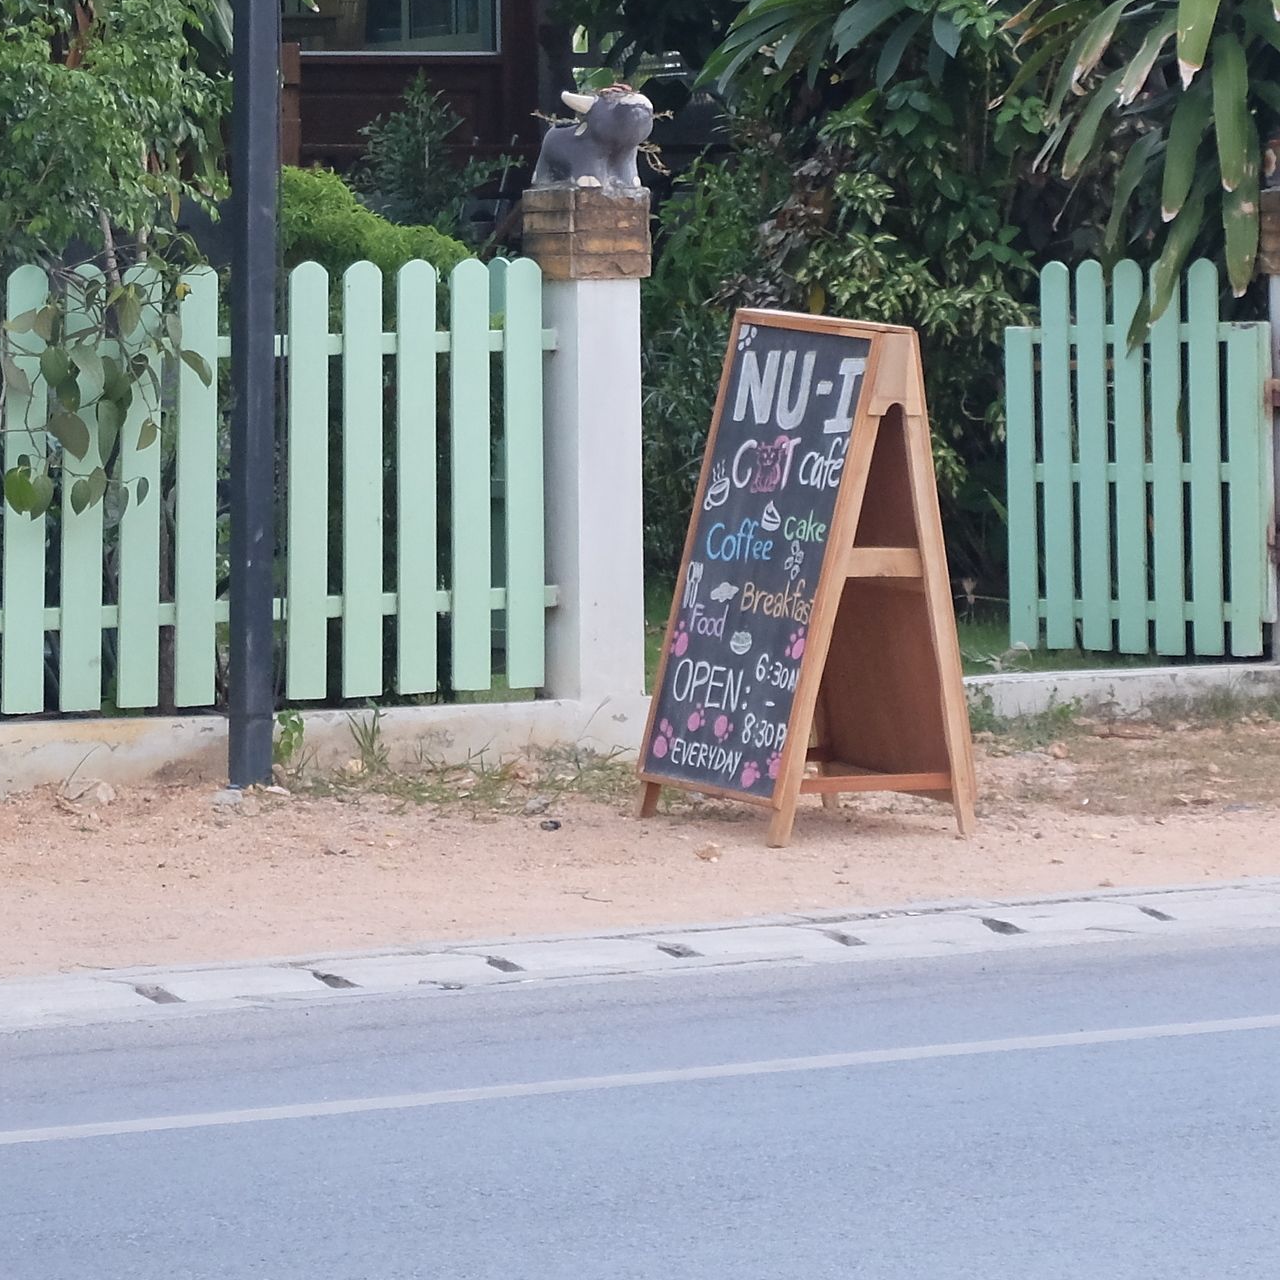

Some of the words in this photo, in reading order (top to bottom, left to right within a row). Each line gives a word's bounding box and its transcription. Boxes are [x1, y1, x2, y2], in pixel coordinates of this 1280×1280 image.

[733, 350, 866, 431] NU-I
[706, 517, 774, 563] Coffee
[689, 602, 730, 641] Food
[672, 658, 752, 712] OPEN:
[755, 653, 801, 692] 6:30A
[671, 737, 743, 781] EVERYDAY
